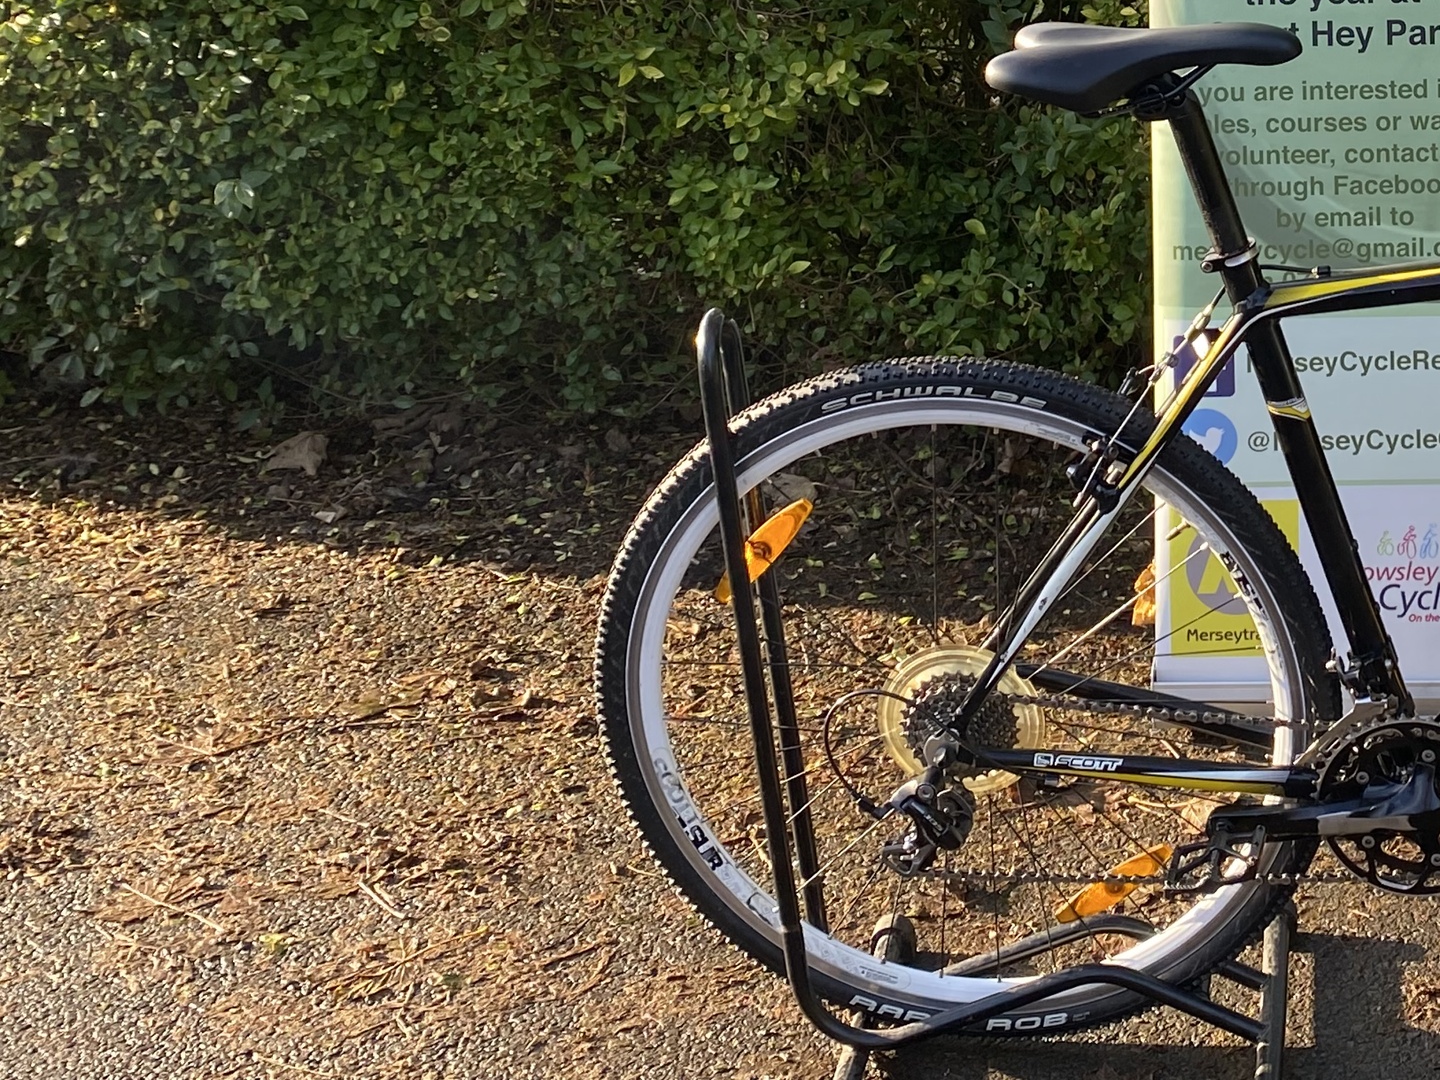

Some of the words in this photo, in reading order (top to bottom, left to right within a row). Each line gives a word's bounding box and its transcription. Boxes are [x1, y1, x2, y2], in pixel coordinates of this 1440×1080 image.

[1311, 21, 1375, 53] Hey
[1199, 85, 1245, 107] you
[1254, 84, 1294, 101] are
[1301, 78, 1428, 101] interested
[1208, 113, 1257, 137] les,
[1265, 113, 1367, 133] courses
[1375, 114, 1402, 132] or
[1344, 144, 1439, 163] contact
[1231, 176, 1325, 202] hrough
[1276, 208, 1306, 232] by
[1314, 207, 1382, 227] email
[1390, 207, 1414, 226] to
[821, 386, 1047, 414] SCHWALBE
[1364, 561, 1439, 586] owsley
[1409, 613, 1423, 623] On
[1425, 613, 1440, 623] the
[1187, 629, 1261, 644] Merseytra
[1055, 756, 1123, 771] SCOTT
[986, 1013, 1068, 1031] ROB
